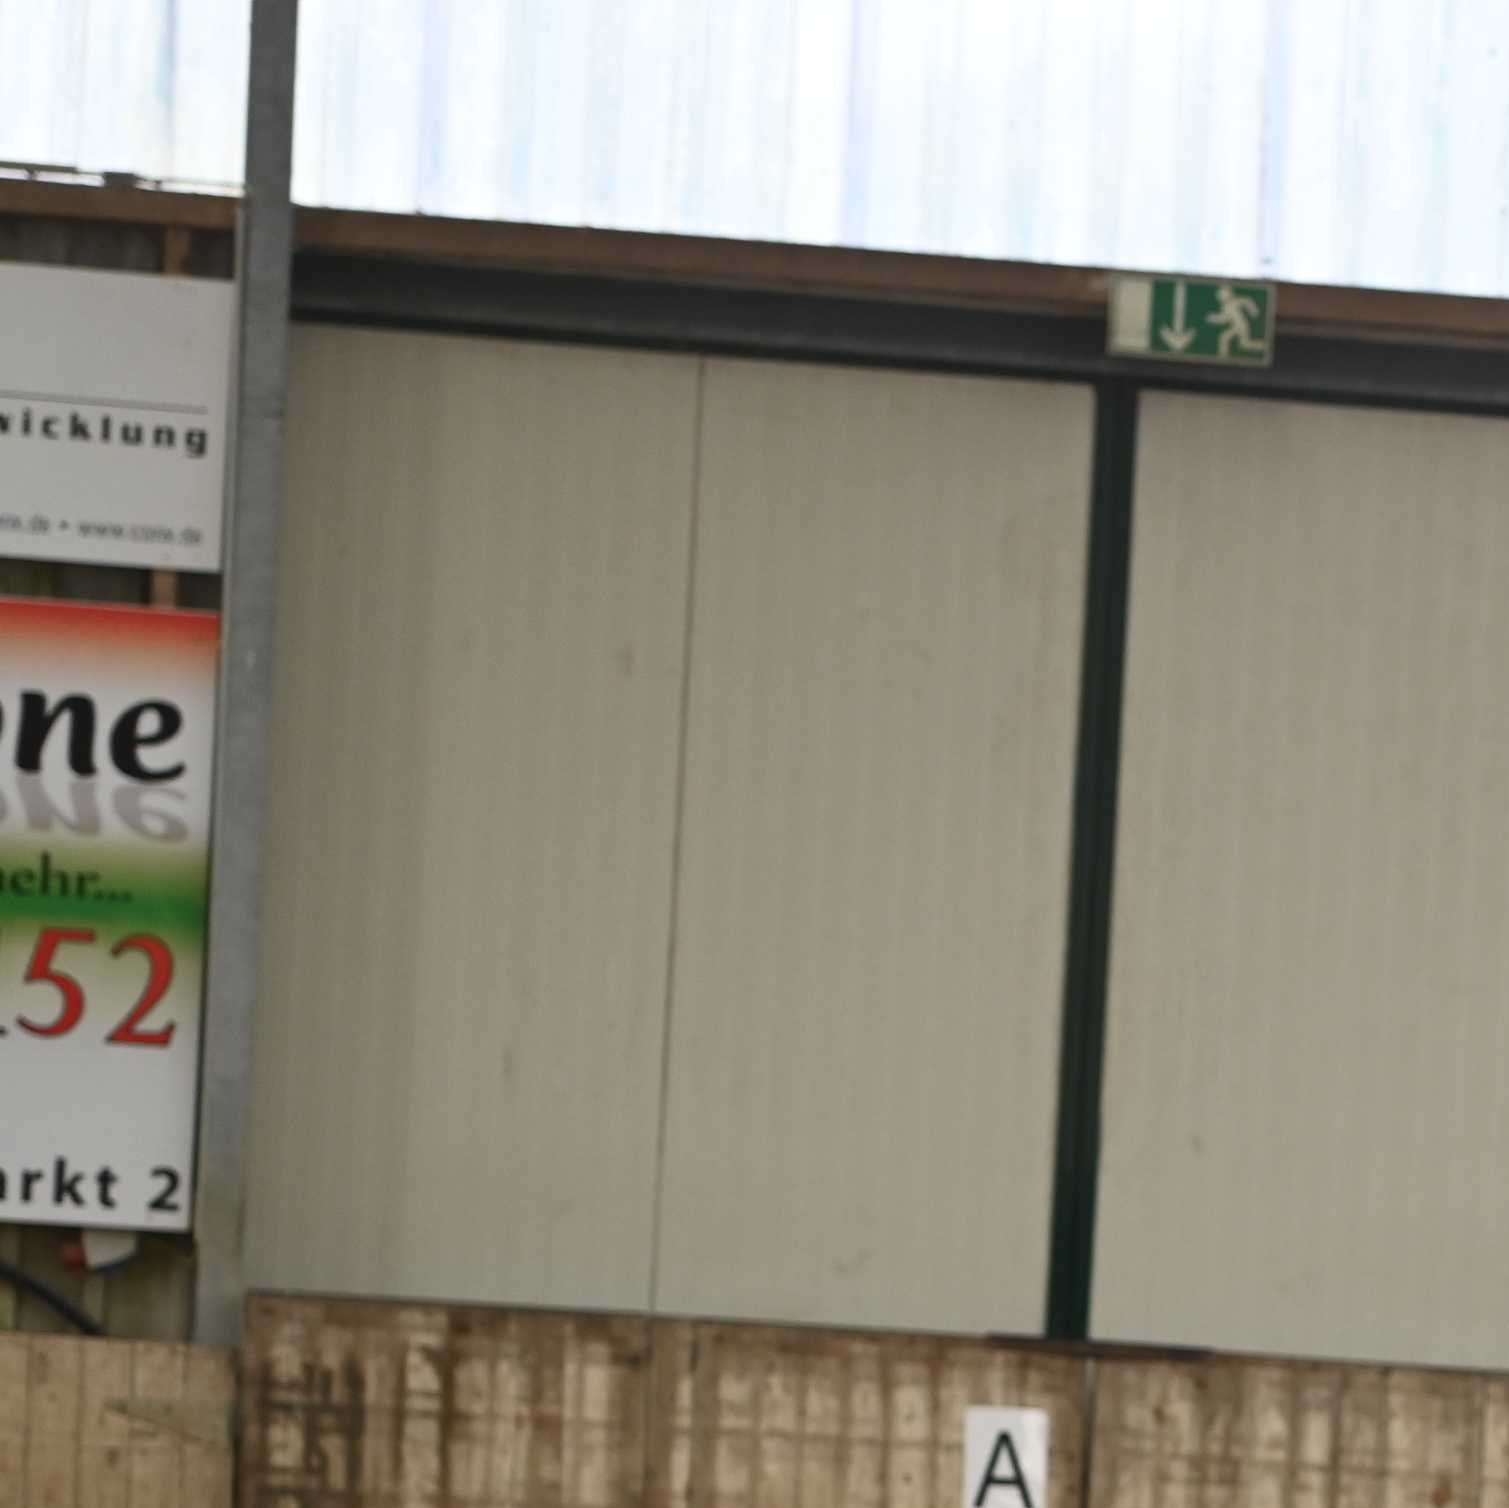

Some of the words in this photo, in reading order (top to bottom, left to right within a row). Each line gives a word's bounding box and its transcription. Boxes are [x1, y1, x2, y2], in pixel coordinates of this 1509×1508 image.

[0, 689, 187, 783] ne
[0, 1156, 118, 1209] rkt
[147, 1166, 181, 1212] 2
